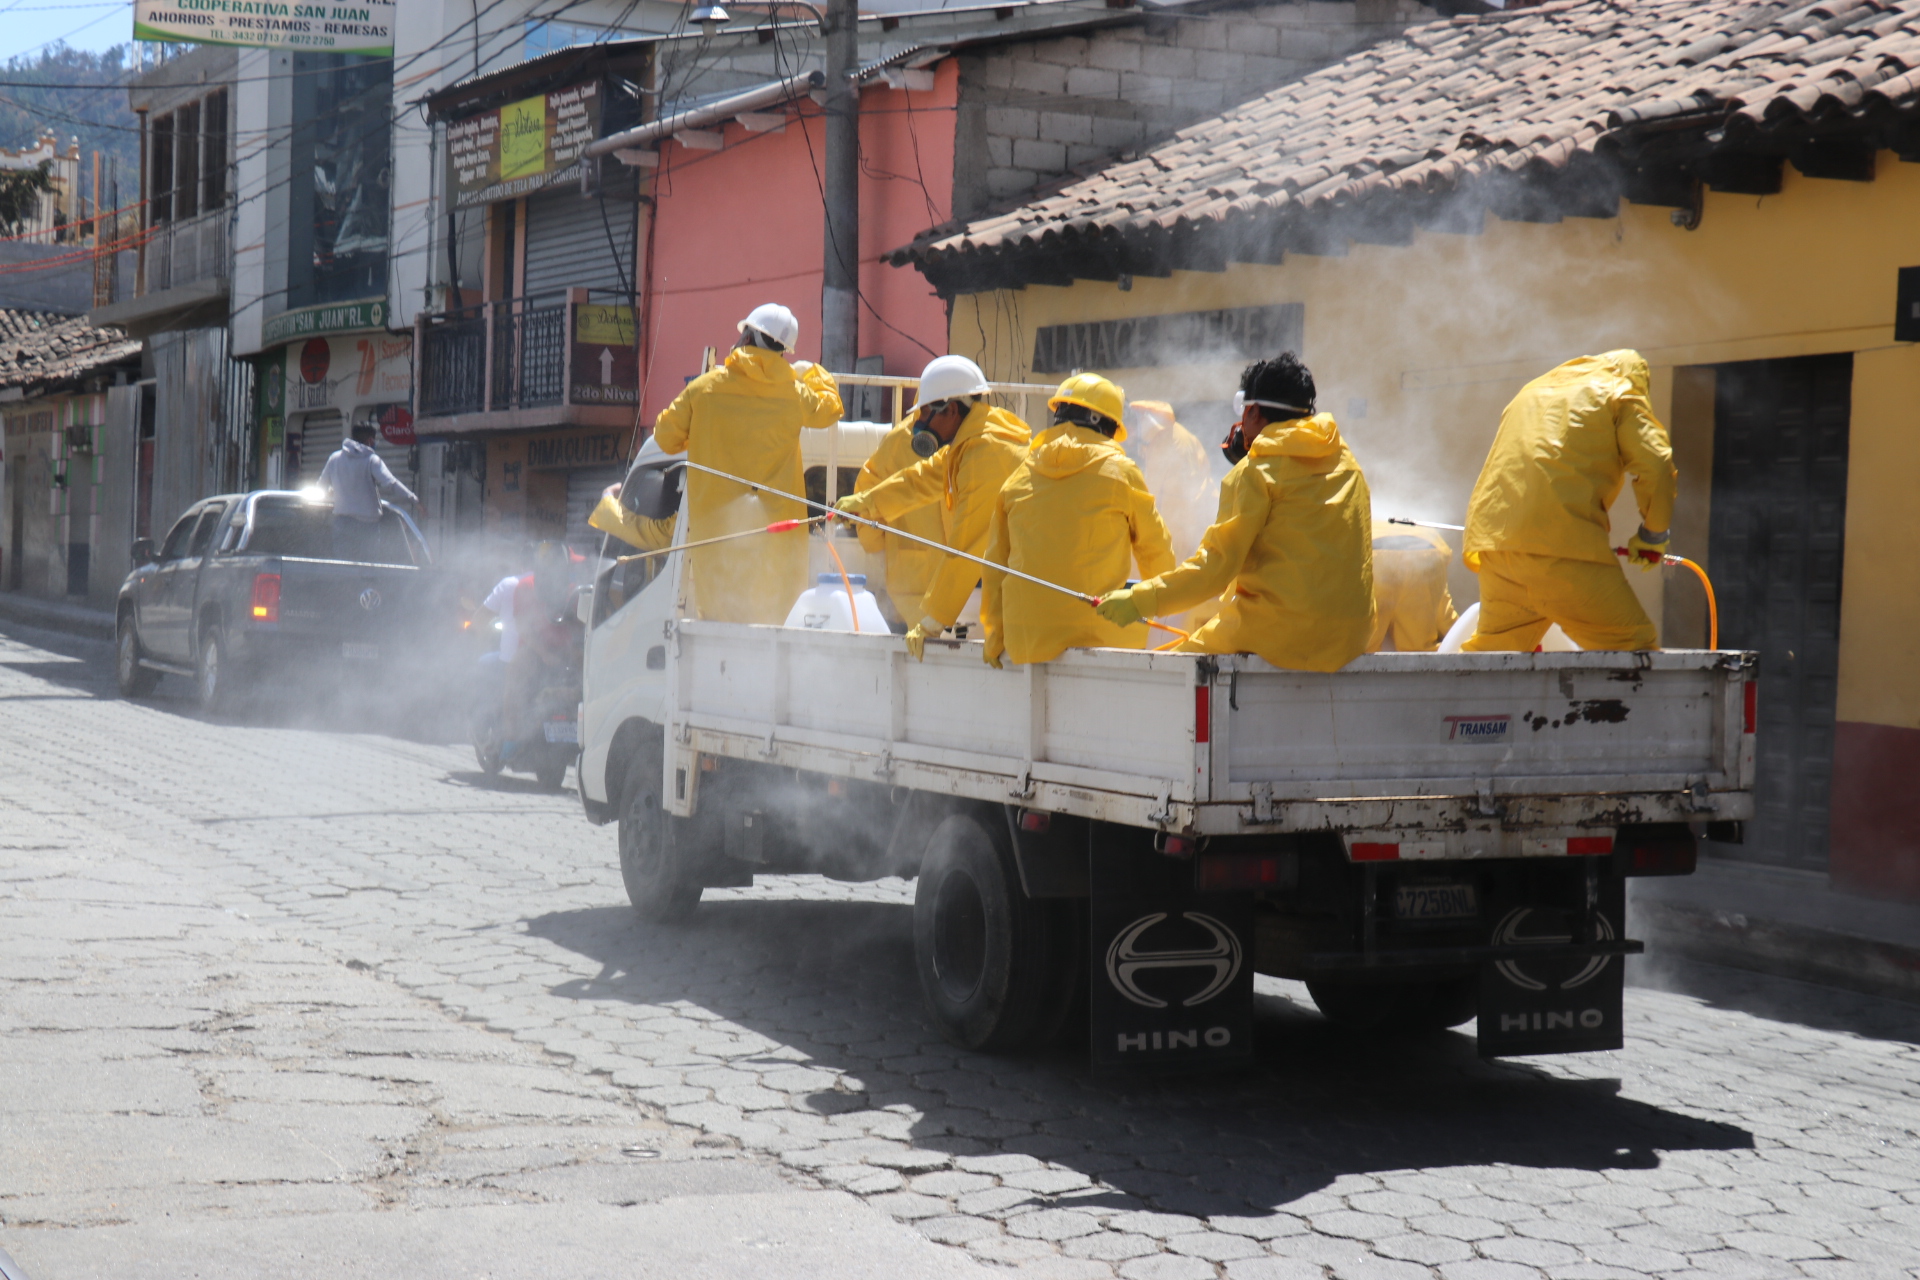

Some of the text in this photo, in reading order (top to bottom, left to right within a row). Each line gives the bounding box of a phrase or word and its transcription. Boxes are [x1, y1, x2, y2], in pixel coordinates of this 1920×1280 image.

[177, 0, 370, 21] COOPERATIVA SAN JUAN
[148, 11, 215, 26] AHORROS
[228, 16, 311, 32] PRESTAMOS
[324, 22, 388, 37] REMESAS
[232, 30, 256, 41] 3432
[257, 33, 280, 43] 0713
[479, 183, 504, 202] SURTIDO
[504, 181, 512, 195] DE
[513, 178, 528, 194] TELA
[528, 175, 543, 190] PARA
[573, 386, 639, 400] 2do Nivel
[385, 424, 411, 435] Claro
[527, 434, 620, 466] DIMAQUITEX
[1460, 721, 1507, 736] TRANSAM
[1501, 1008, 1603, 1032] HINO
[1117, 1026, 1231, 1052] HINO
